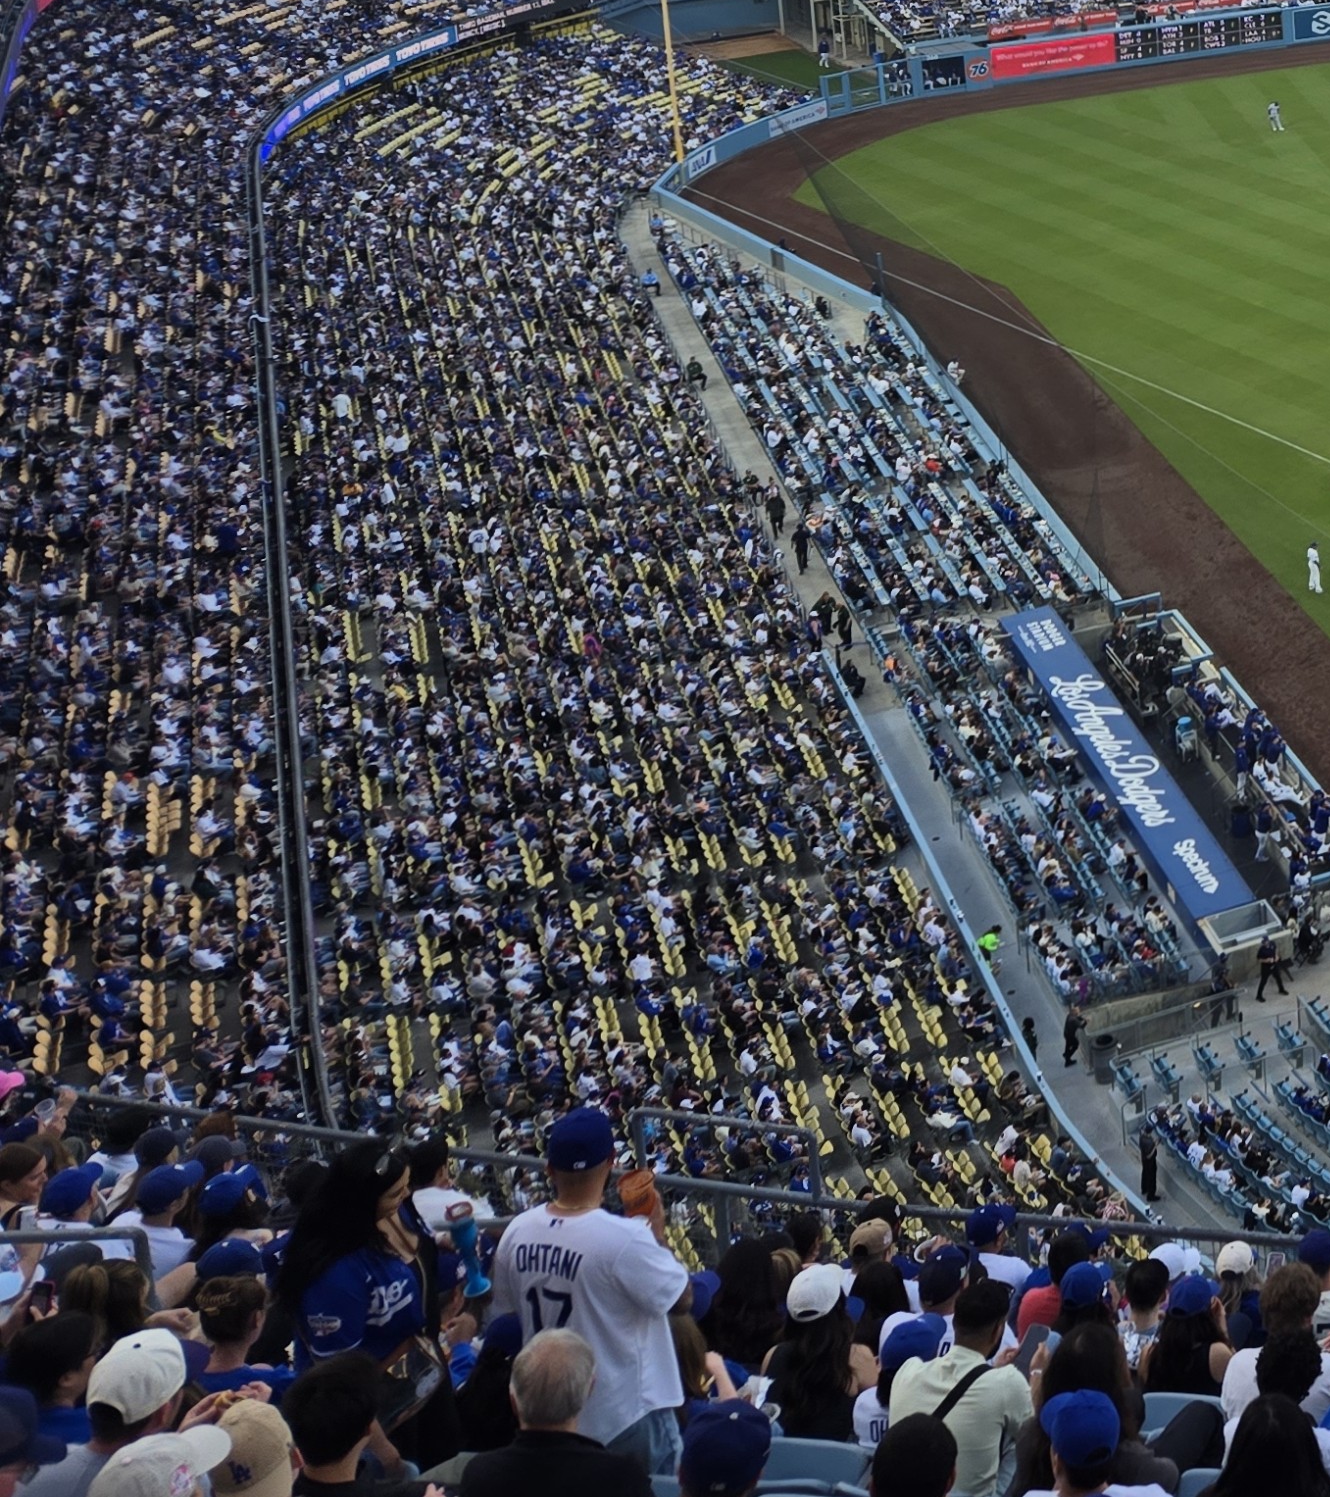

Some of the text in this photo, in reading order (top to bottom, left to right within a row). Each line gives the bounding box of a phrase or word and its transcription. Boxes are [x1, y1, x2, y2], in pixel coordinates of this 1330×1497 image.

[969, 62, 988, 76] 76
[691, 157, 707, 173] ANA
[1026, 621, 1054, 652] STADIUM
[1040, 619, 1067, 647] DODGER
[1049, 674, 1175, 828] Los Angeles Dodgers
[1173, 838, 1217, 892] Spectrum
[515, 1243, 584, 1282] OHTANI
[526, 1286, 573, 1334] 17
